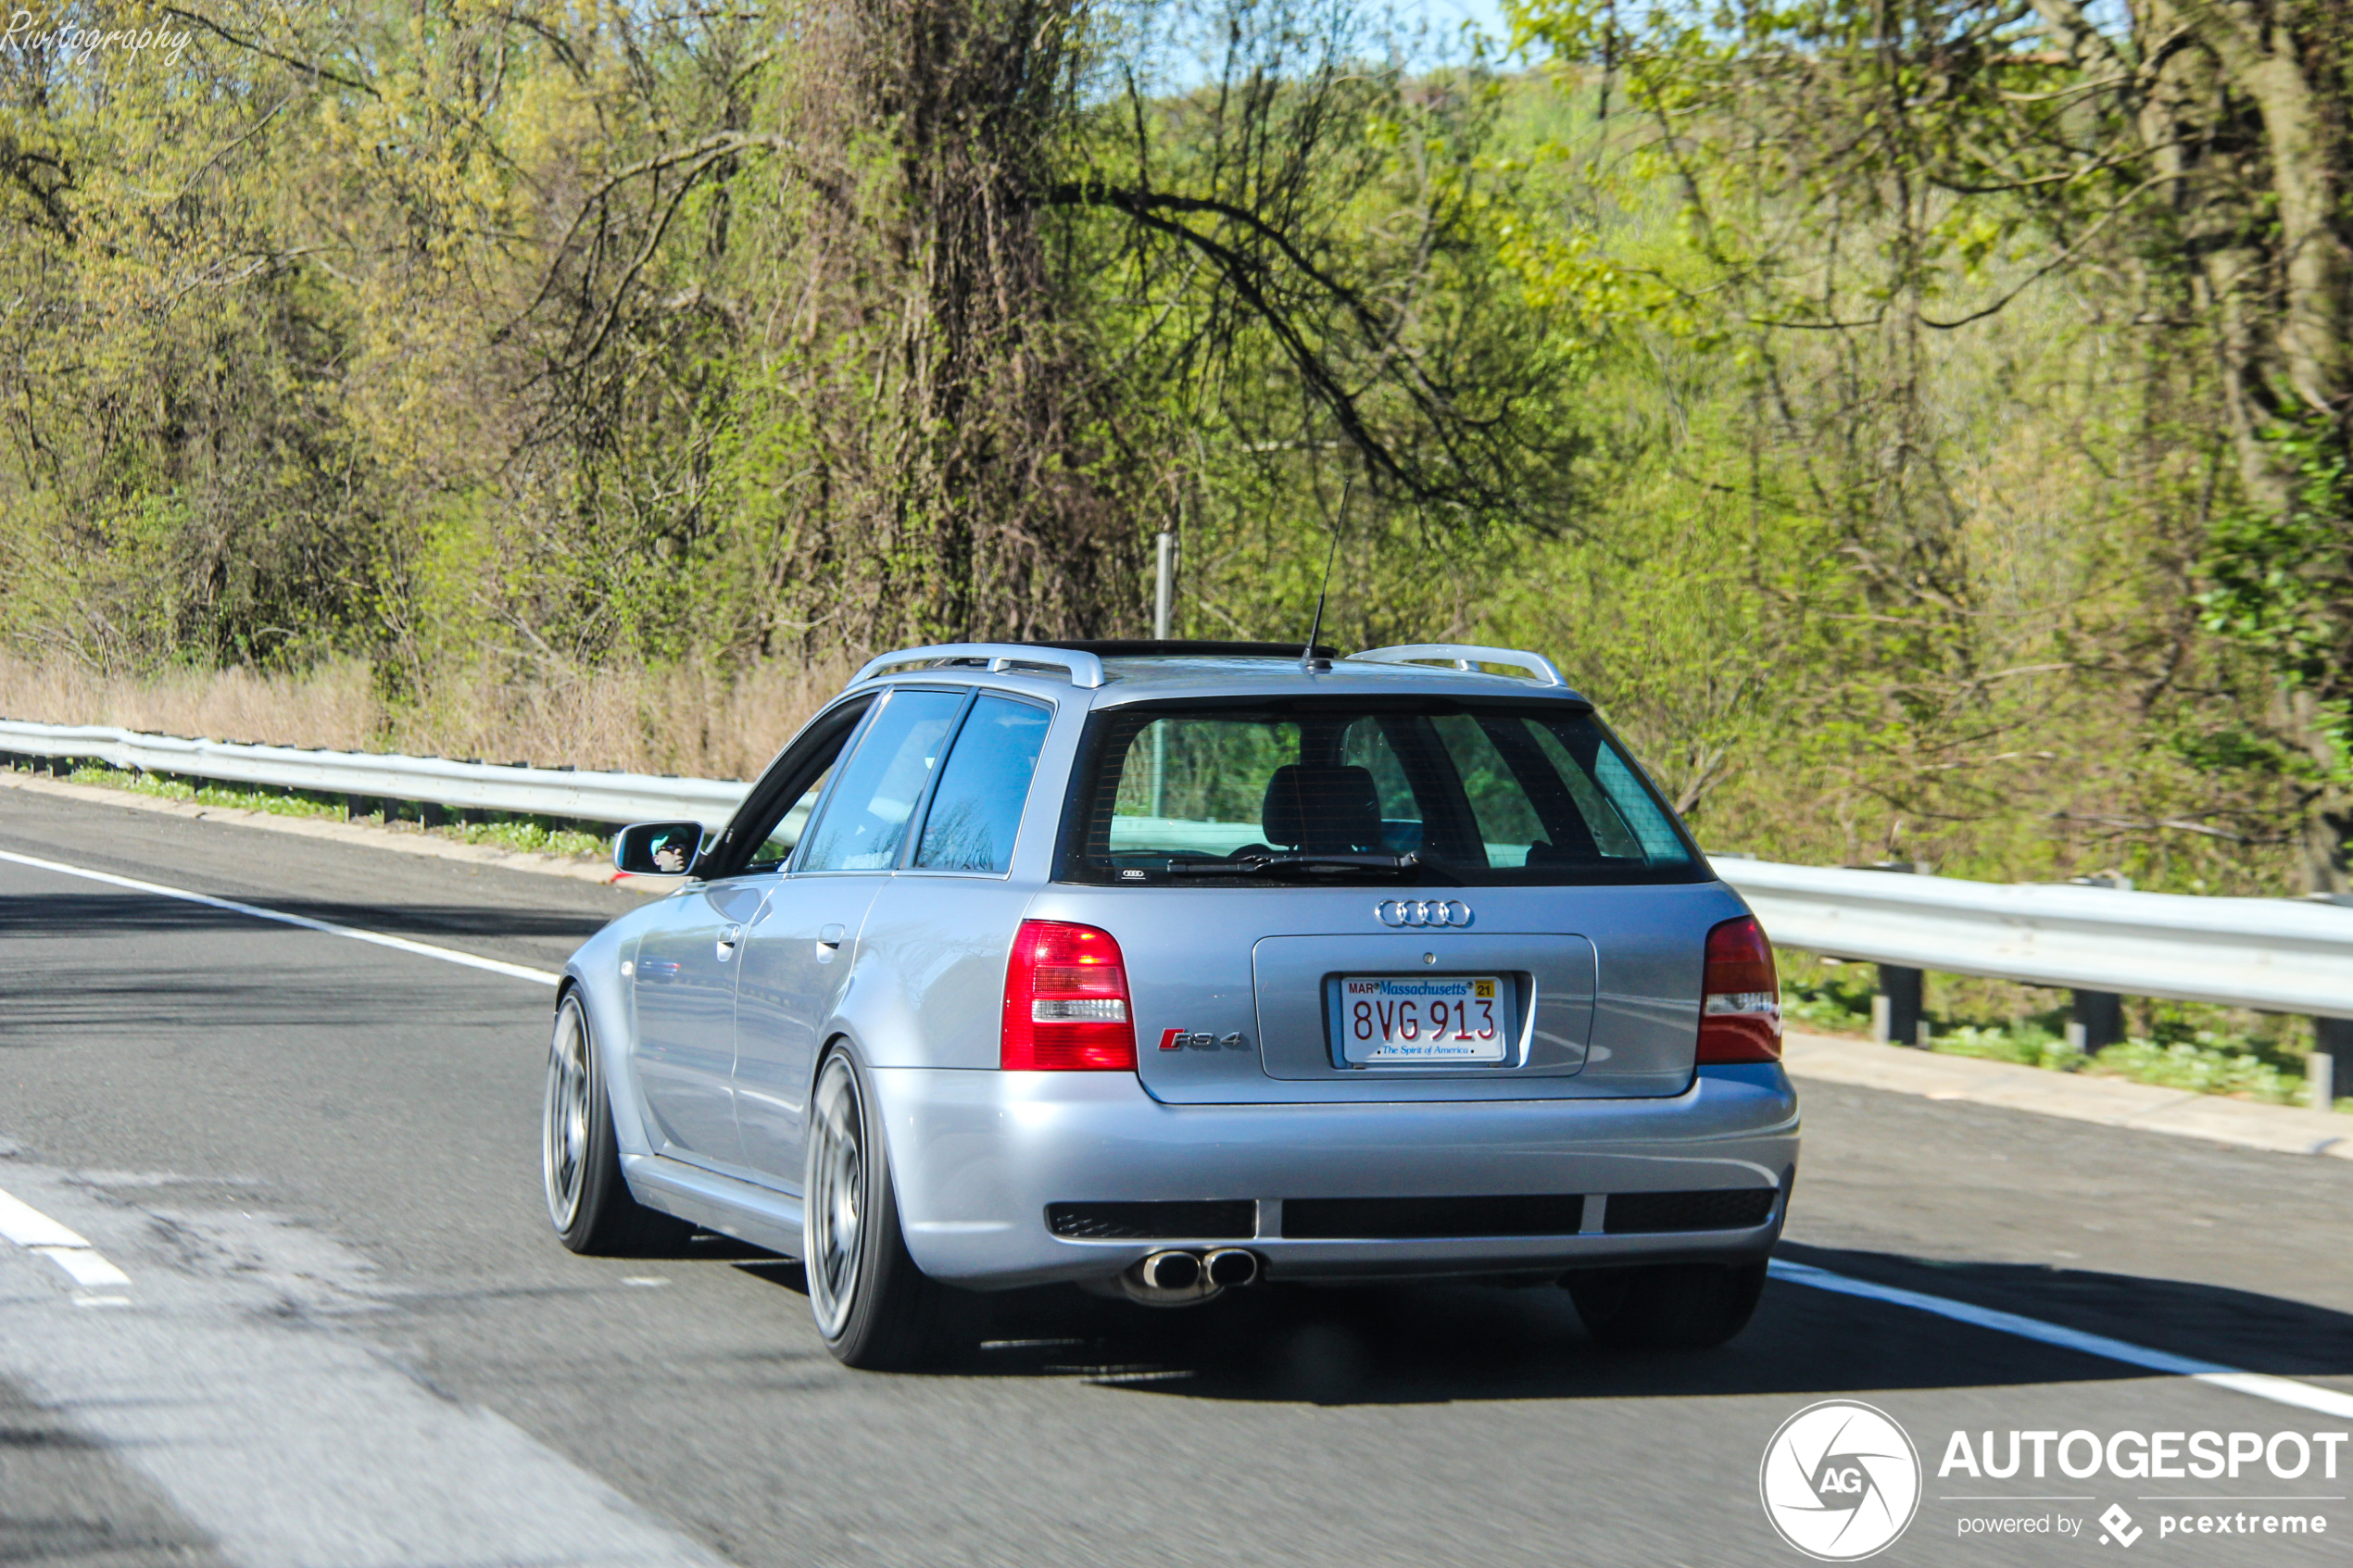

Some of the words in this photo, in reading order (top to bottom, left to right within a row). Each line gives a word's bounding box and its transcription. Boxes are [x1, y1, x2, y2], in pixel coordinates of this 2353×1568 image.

[1349, 983, 1374, 994] MAR
[1379, 981, 1466, 996] Massachusetts
[1478, 985, 1491, 996] 21
[1353, 1000, 1417, 1041] 8VG
[1429, 999, 1494, 1041] 913
[1170, 1031, 1214, 1047] RS
[1220, 1031, 1240, 1046] 4
[1382, 1046, 1398, 1054] The
[1401, 1045, 1422, 1055] Spirit
[1424, 1046, 1432, 1055] of
[1434, 1046, 1468, 1054] America
